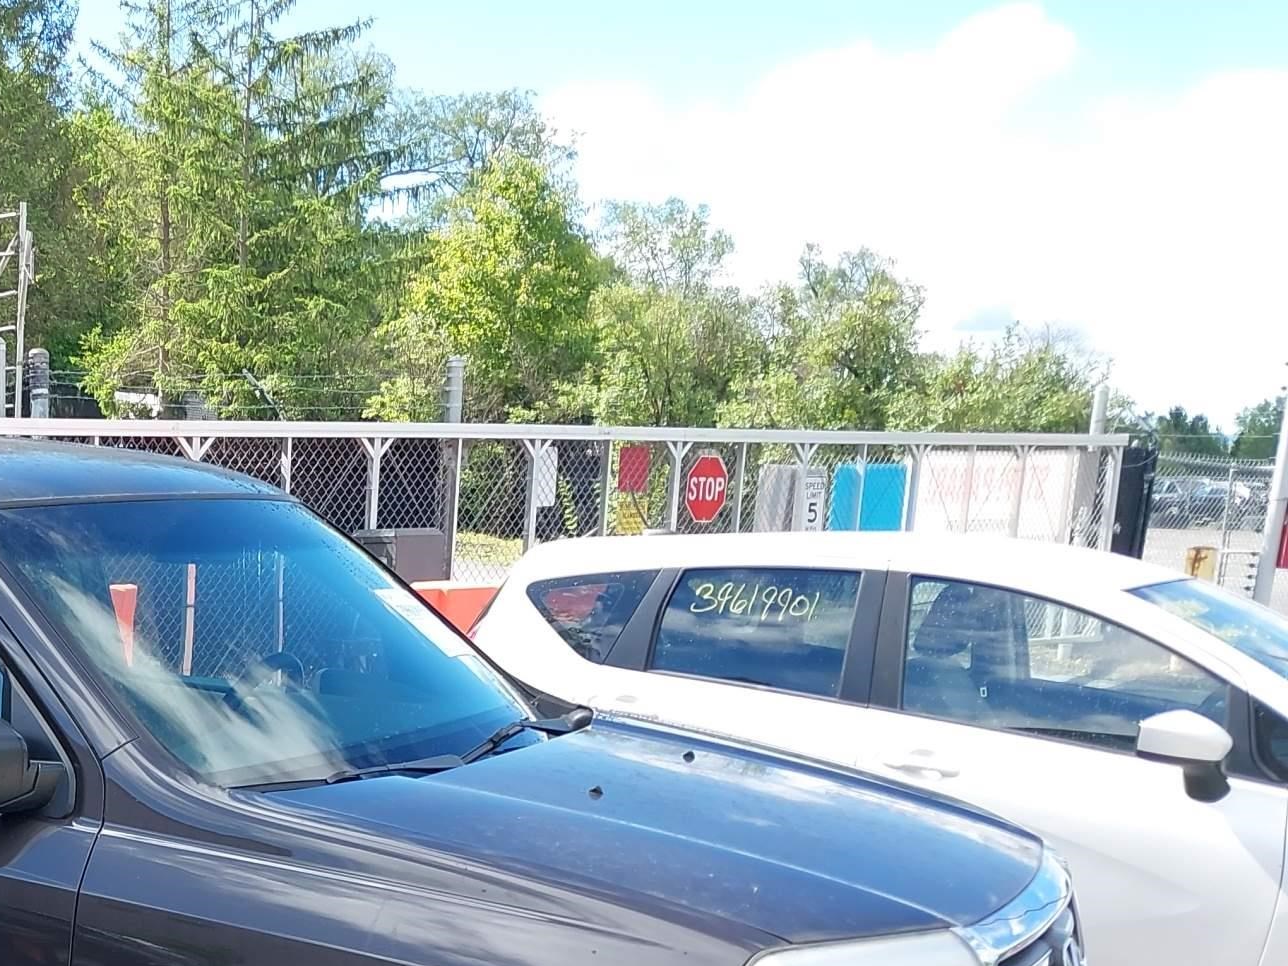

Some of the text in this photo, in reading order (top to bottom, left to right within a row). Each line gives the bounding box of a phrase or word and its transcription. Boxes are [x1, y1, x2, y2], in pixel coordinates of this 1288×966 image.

[688, 476, 725, 501] STOP
[805, 482, 824, 490] SPEED
[806, 491, 822, 499] LIMIT
[807, 502, 818, 523] 5
[690, 582, 819, 621] 39619901
